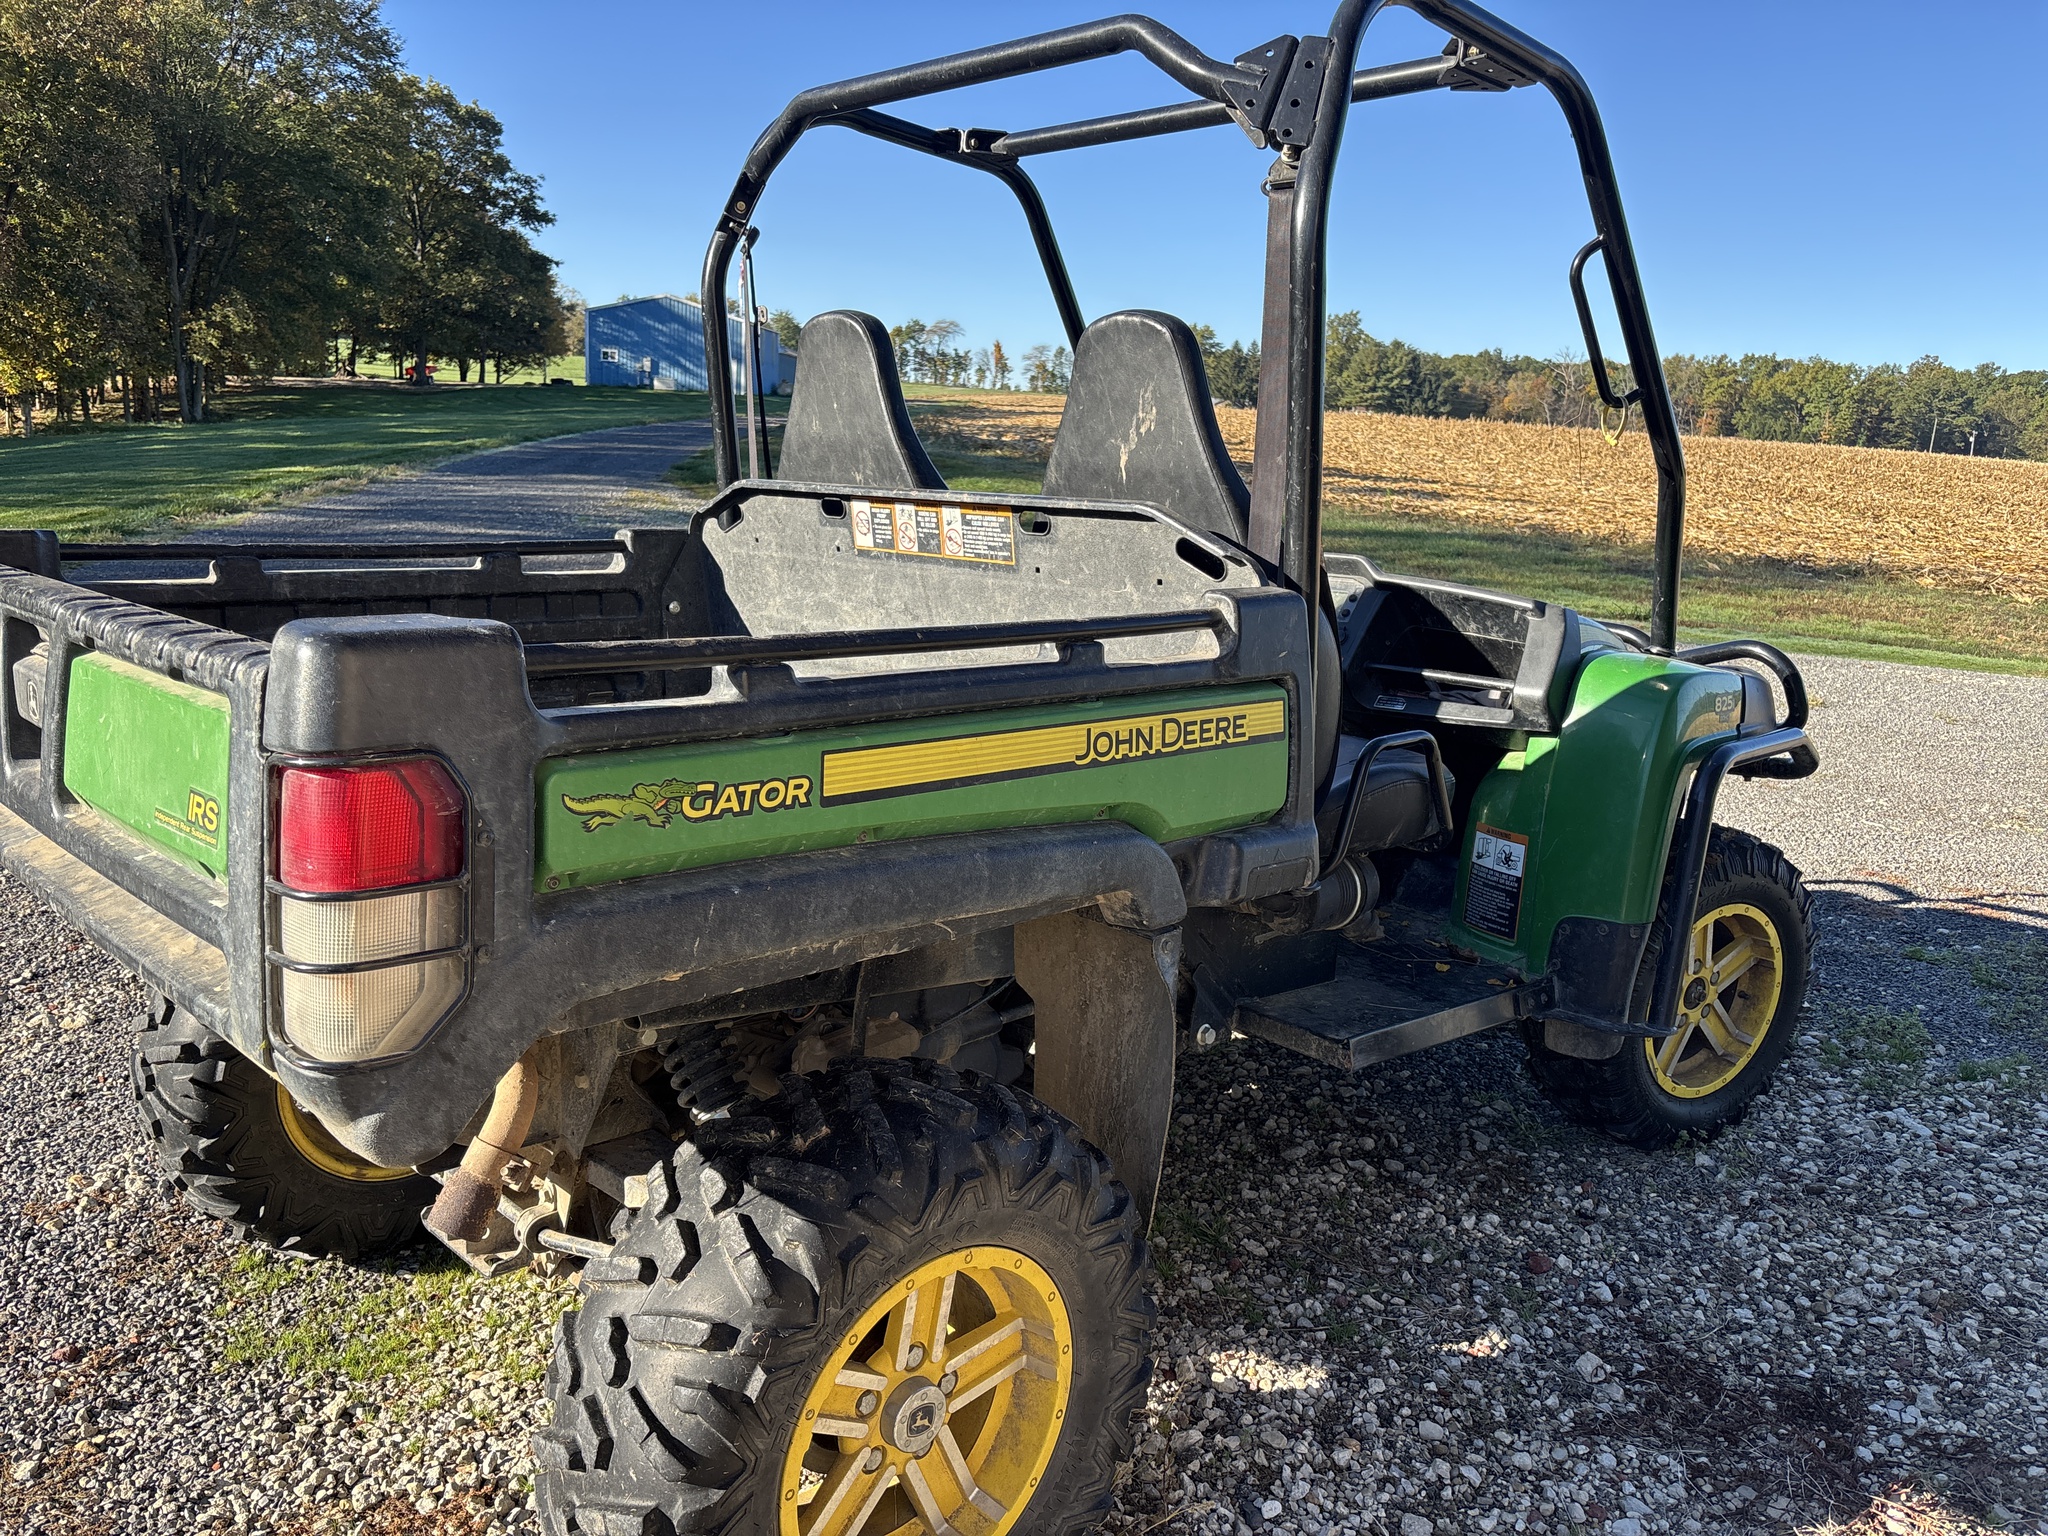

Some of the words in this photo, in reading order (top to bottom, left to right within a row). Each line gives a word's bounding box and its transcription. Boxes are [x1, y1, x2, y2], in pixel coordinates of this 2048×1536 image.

[1075, 726, 1154, 761] JOHN
[1161, 714, 1248, 750] DEERE
[187, 792, 219, 831] IRS
[681, 776, 812, 821] GATOR
